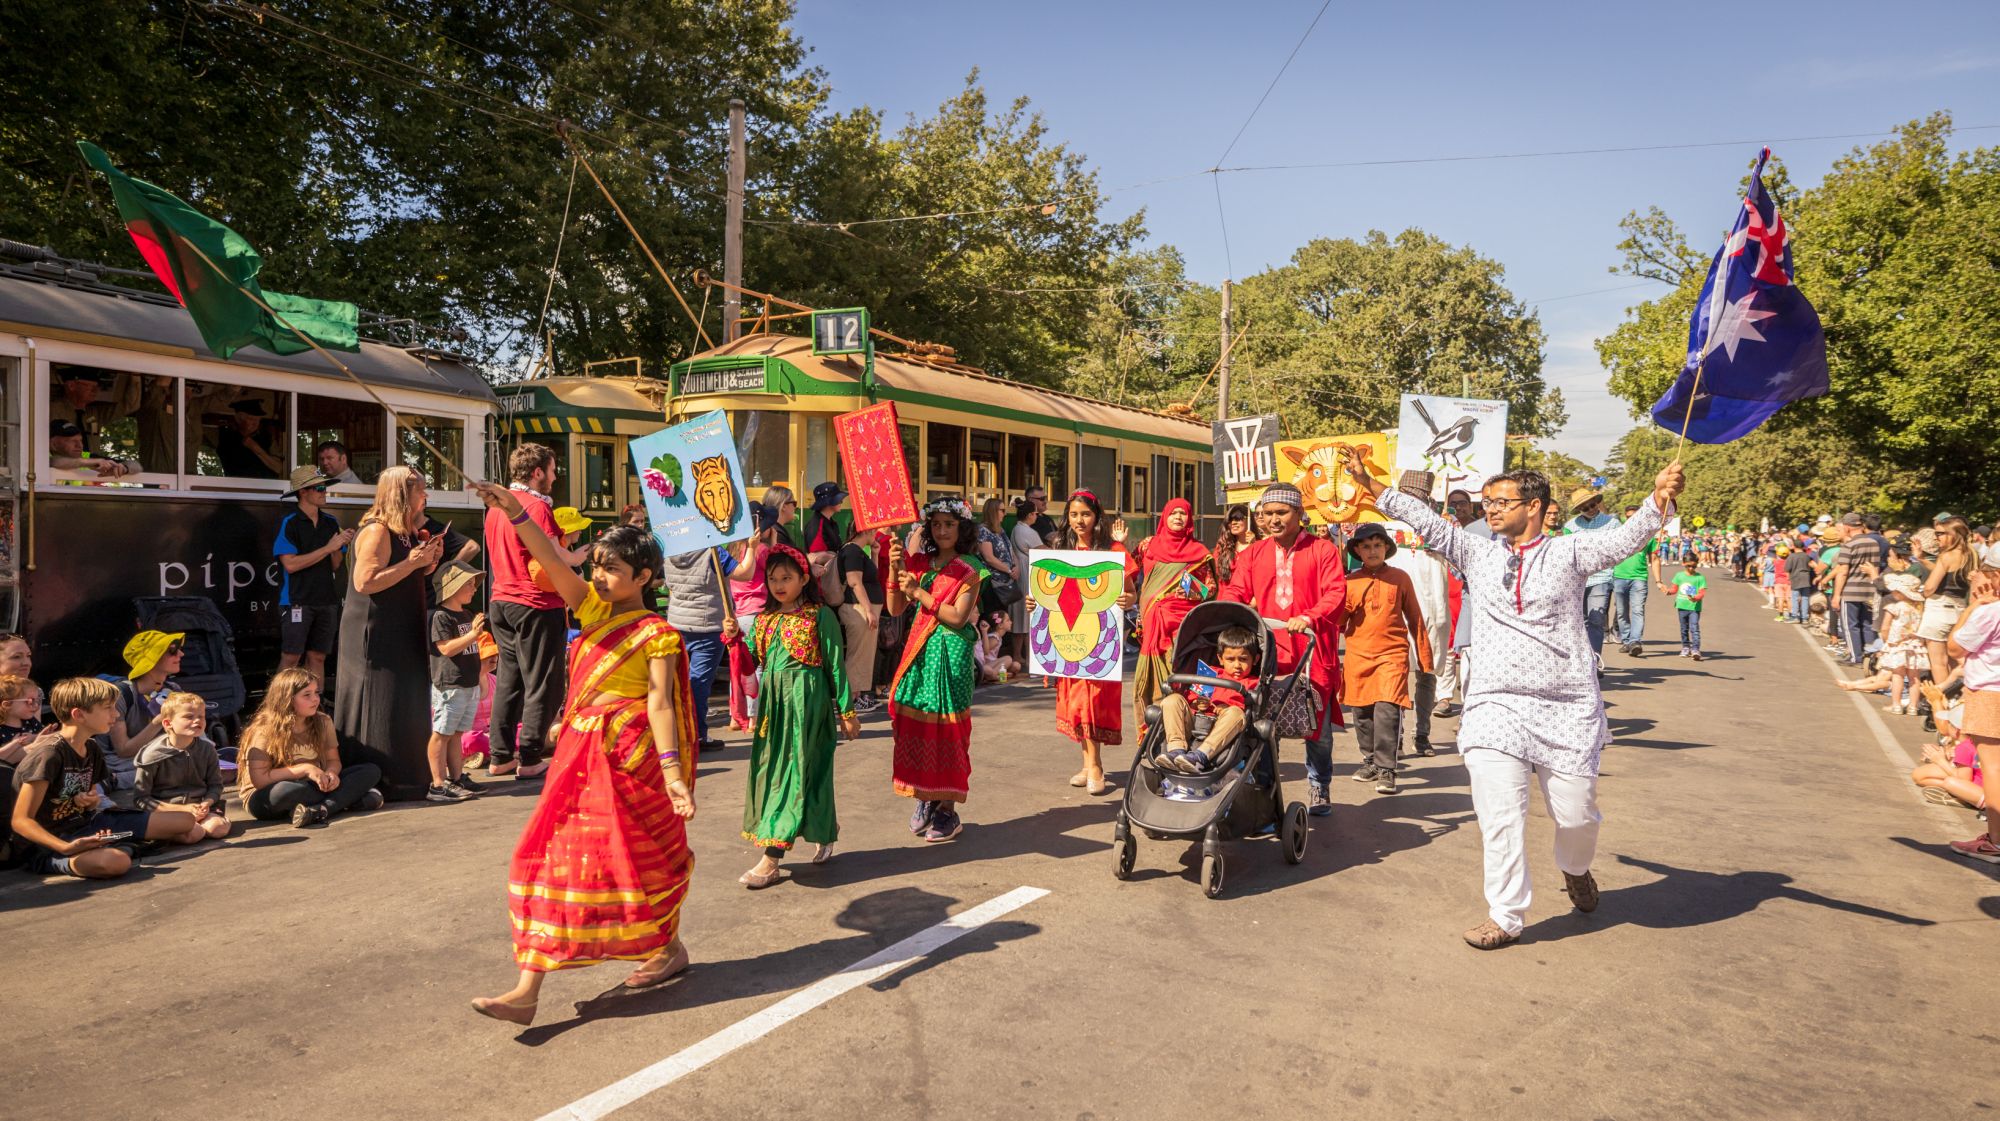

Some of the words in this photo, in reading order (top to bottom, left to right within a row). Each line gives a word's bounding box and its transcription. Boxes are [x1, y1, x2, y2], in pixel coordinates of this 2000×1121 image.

[827, 317, 859, 348] 12
[680, 373, 706, 393] SOUTH
[738, 377, 764, 388] BEACH
[250, 601, 270, 611] BY
